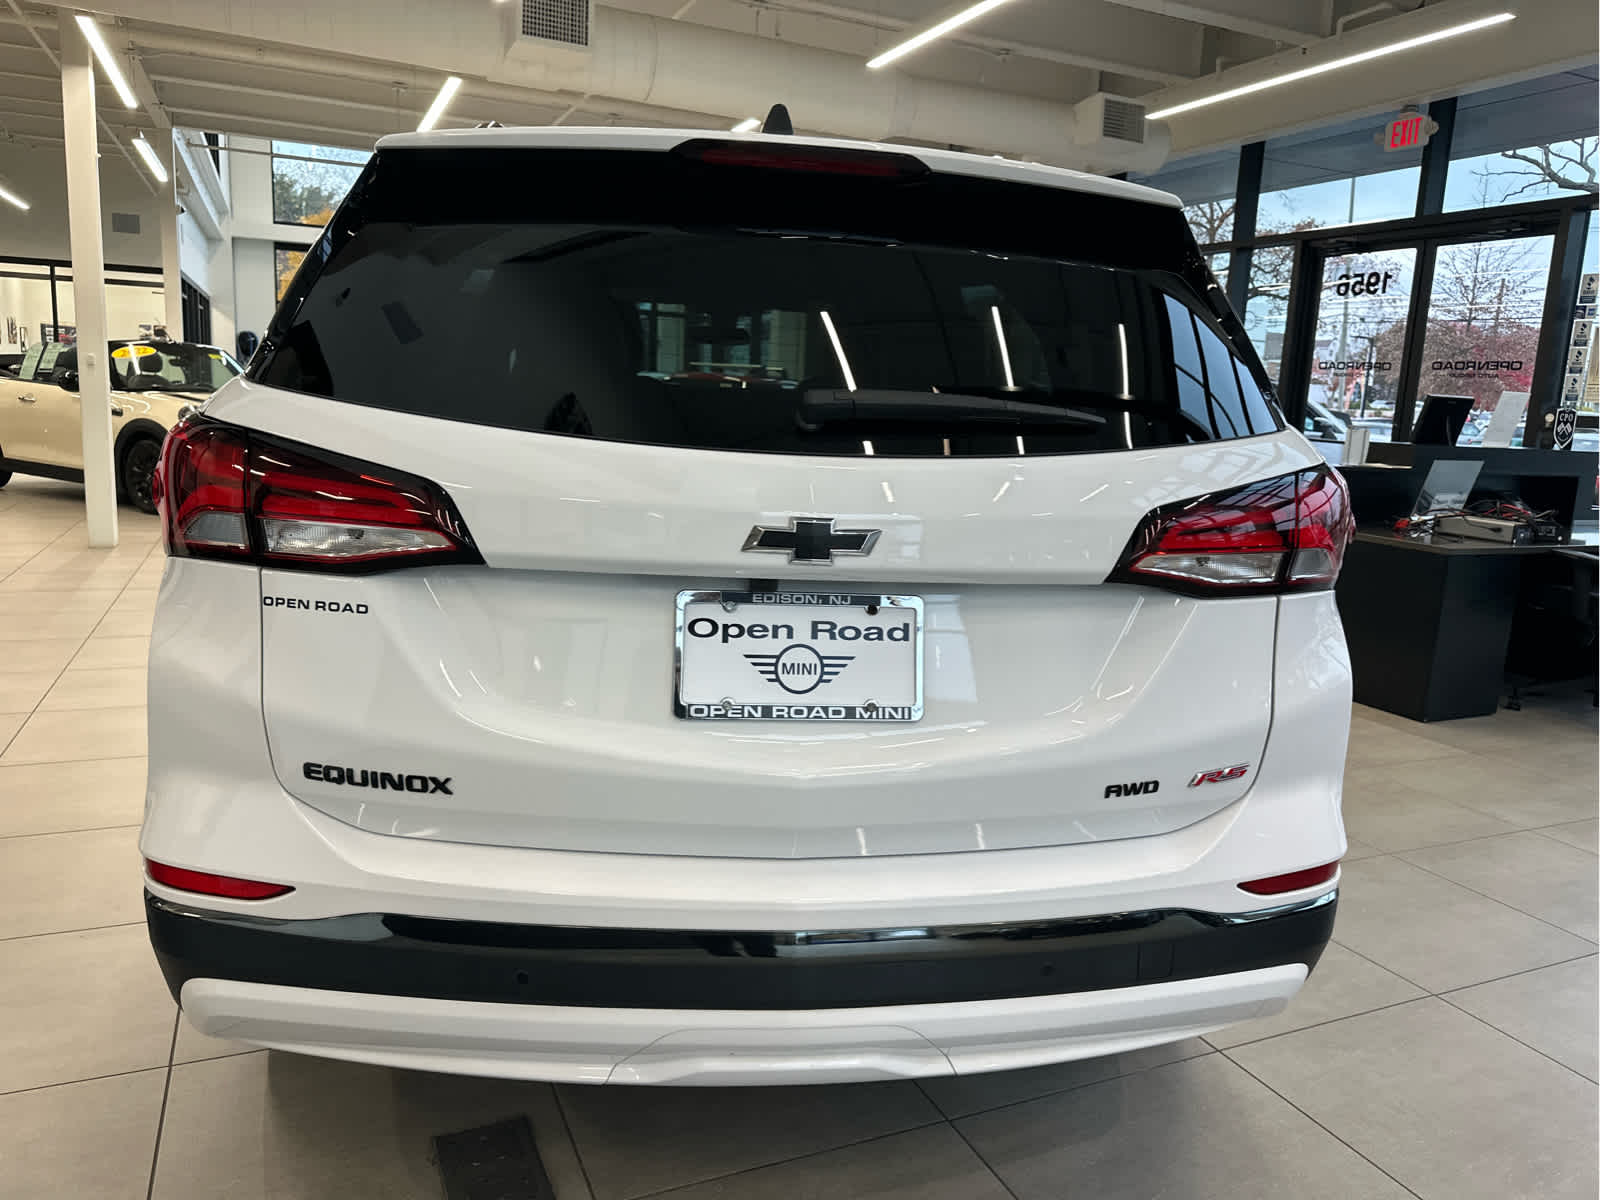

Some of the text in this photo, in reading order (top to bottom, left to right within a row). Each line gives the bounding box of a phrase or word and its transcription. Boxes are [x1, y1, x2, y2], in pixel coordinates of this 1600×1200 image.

[1389, 116, 1424, 149] EXIT
[1559, 413, 1574, 422] CPO
[263, 596, 369, 614] OPEN ROAD
[752, 593, 851, 606] EDISON, NJ
[687, 617, 910, 644] Open Road
[781, 662, 818, 676] MINI
[689, 703, 910, 720] OPEN ROAD MINI
[303, 762, 453, 795] EQUINOX
[1187, 762, 1251, 788] RS
[1104, 780, 1160, 799] AWD
